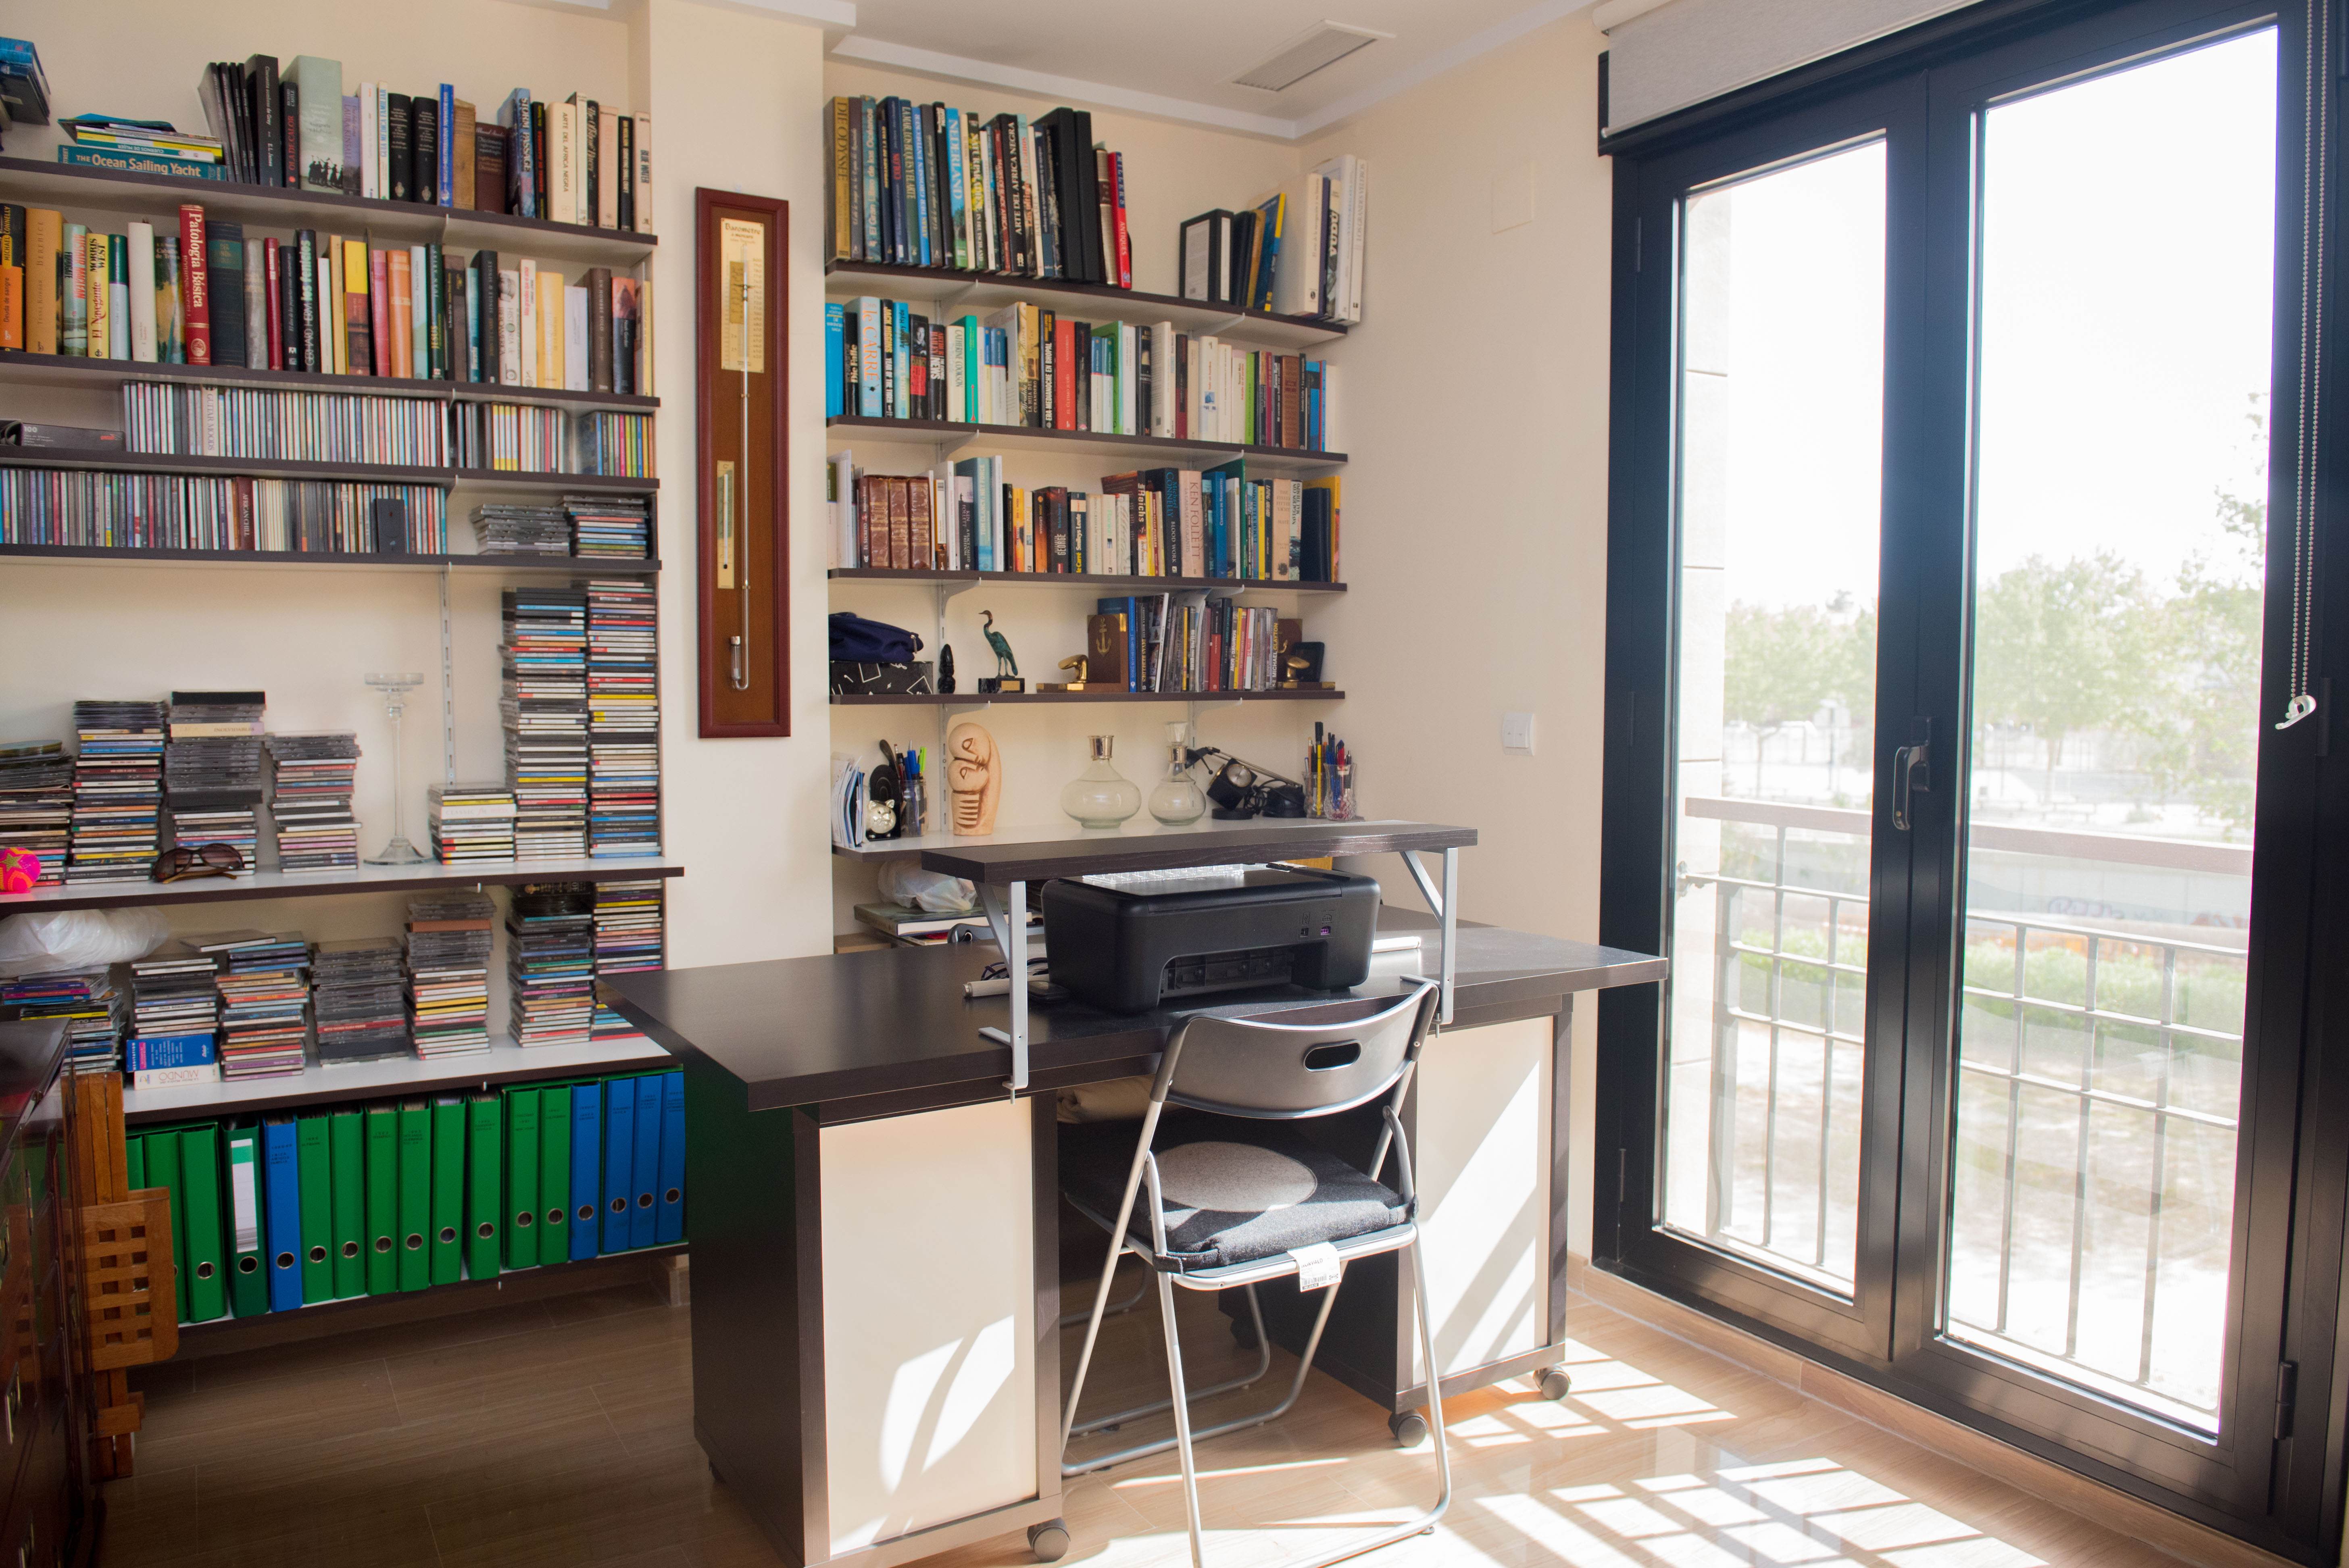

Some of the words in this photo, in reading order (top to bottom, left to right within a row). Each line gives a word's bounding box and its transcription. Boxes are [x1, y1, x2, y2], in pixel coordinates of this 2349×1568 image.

[519, 98, 530, 128] STORM
[836, 102, 848, 125] DIE
[902, 106, 911, 115] LA
[865, 108, 874, 148] Océanos
[905, 132, 913, 144] LOS
[914, 114, 923, 160] ENTDECKER
[1008, 122, 1017, 153] NEGRA
[522, 131, 531, 172] PASSAGE
[640, 150, 649, 163] BLUE
[836, 126, 849, 181] ODYSSEE
[866, 150, 874, 164] los
[905, 144, 915, 169] BUQUES
[948, 119, 963, 200] NEDERLAND
[92, 154, 126, 168] Ocean
[128, 158, 168, 175] Sailing
[169, 163, 201, 177] Yacht
[641, 164, 649, 184] WATER
[867, 165, 875, 177] de
[970, 133, 984, 212] NATURPARADIESE
[1010, 156, 1020, 189] AFRICA
[867, 179, 876, 202] Libro
[907, 175, 916, 184] EL
[907, 183, 916, 200] ARTE
[917, 162, 926, 198] GROSSEN
[1116, 155, 1125, 205] MILLER'S
[1012, 194, 1021, 209] DEL
[868, 204, 877, 225] Gran
[1013, 212, 1022, 235] ARTE
[188, 212, 204, 268] Patología
[869, 227, 877, 235] El
[1329, 210, 1338, 257] VUDÚ
[73, 233, 85, 265] ALISTAIR
[89, 238, 97, 272] MORRIS
[97, 245, 106, 269] WEST
[299, 240, 313, 283] fenicios
[73, 267, 85, 299] MACLEAN
[192, 271, 206, 308] Básica
[300, 285, 313, 302] los
[598, 280, 604, 288] UN
[90, 282, 106, 325] Navegante
[303, 303, 314, 327] HERM
[884, 306, 892, 325] JACK
[862, 310, 877, 322] le
[92, 330, 102, 339] El
[884, 325, 893, 353] HIGGINS
[930, 331, 938, 355] HAILEY
[955, 329, 963, 359] CATHERINE
[304, 328, 315, 366] GERHARD
[862, 326, 880, 381] CARRÉ
[885, 358, 893, 370] YEAR
[930, 357, 940, 380] NEWS
[955, 361, 963, 387] COOKSON
[1045, 365, 1052, 373] EN
[885, 389, 893, 403] TIGER
[1189, 482, 1198, 506] KEN
[1057, 534, 1066, 555] GEORGE
[1190, 510, 1200, 560] FOLLETT
[158, 1069, 199, 1081] MUNDO
